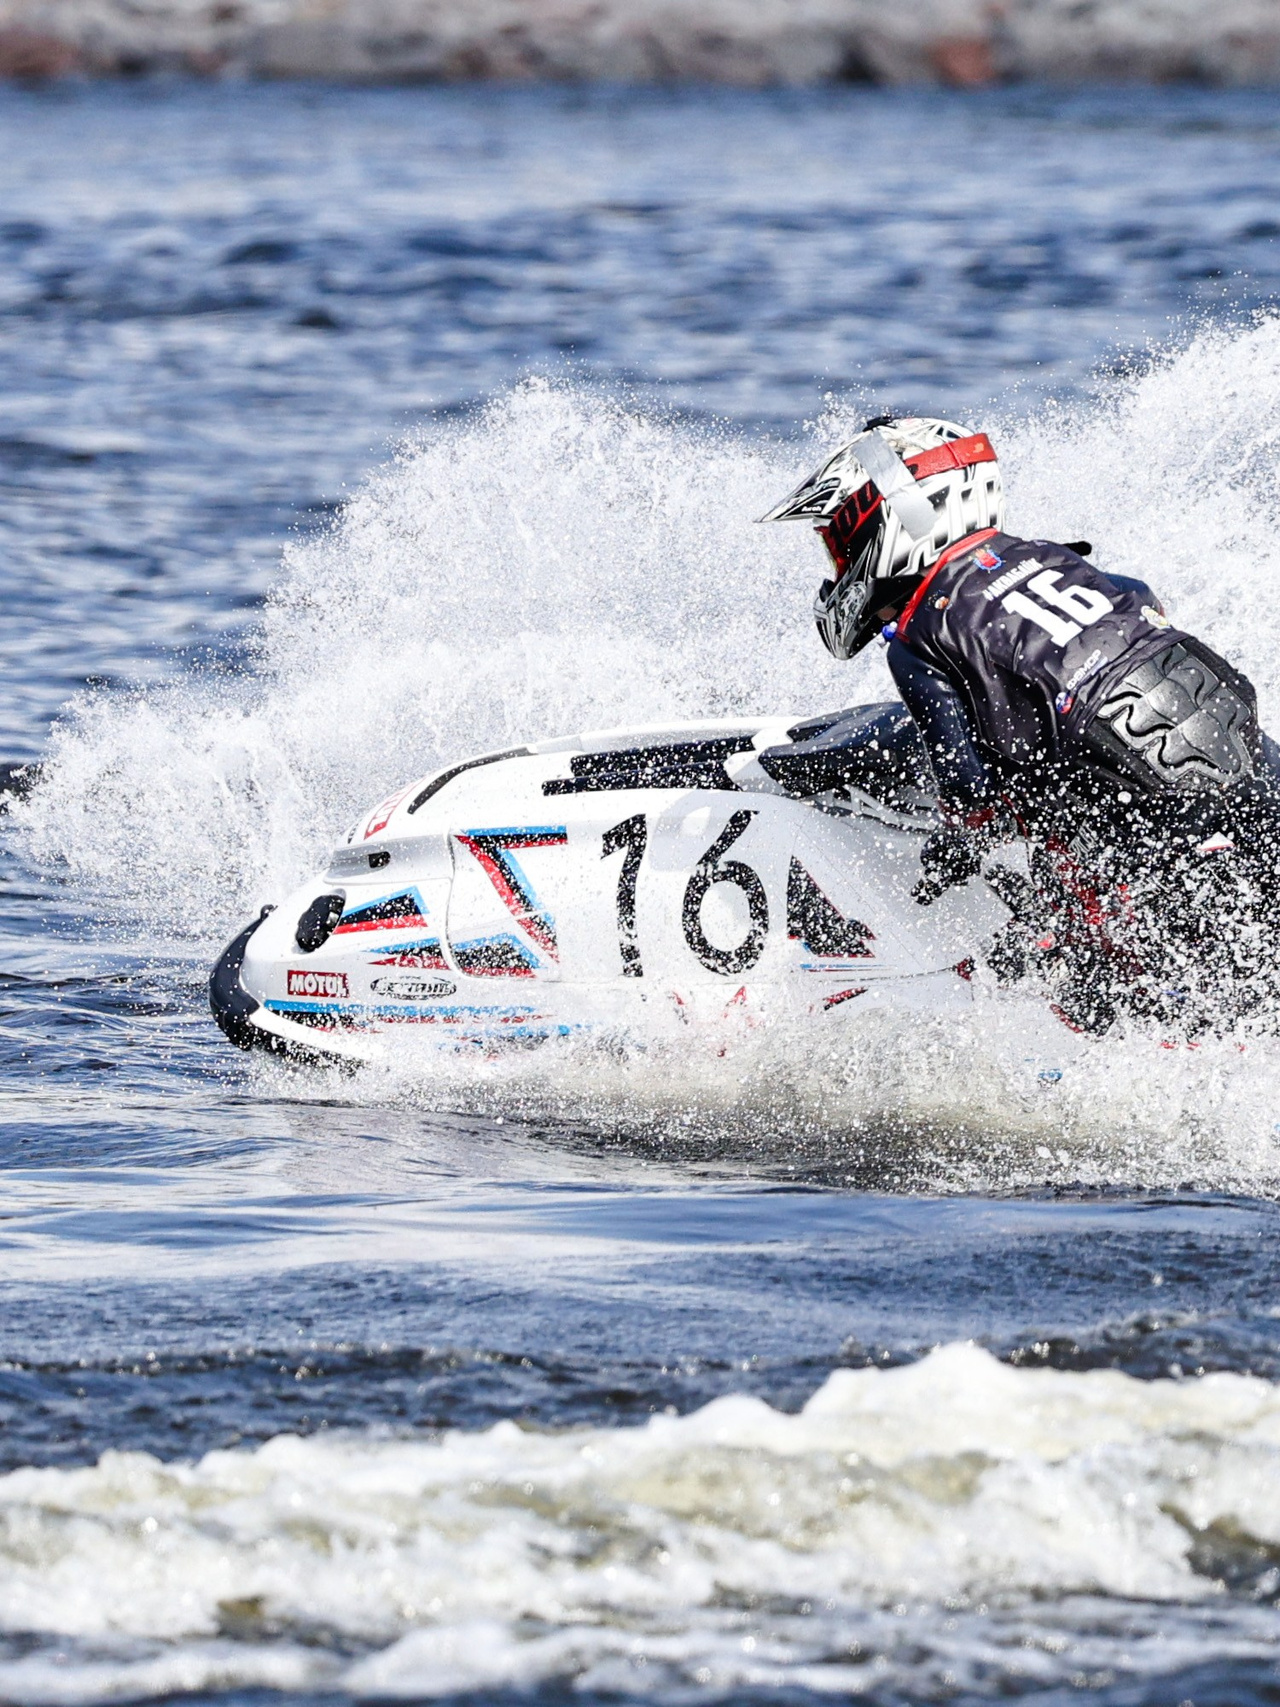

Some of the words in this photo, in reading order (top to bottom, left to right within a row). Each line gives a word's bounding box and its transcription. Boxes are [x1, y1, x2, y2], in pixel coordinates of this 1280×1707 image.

[1001, 568, 1114, 648] 16
[600, 809, 770, 978] 16
[289, 972, 347, 997] MOTUL
